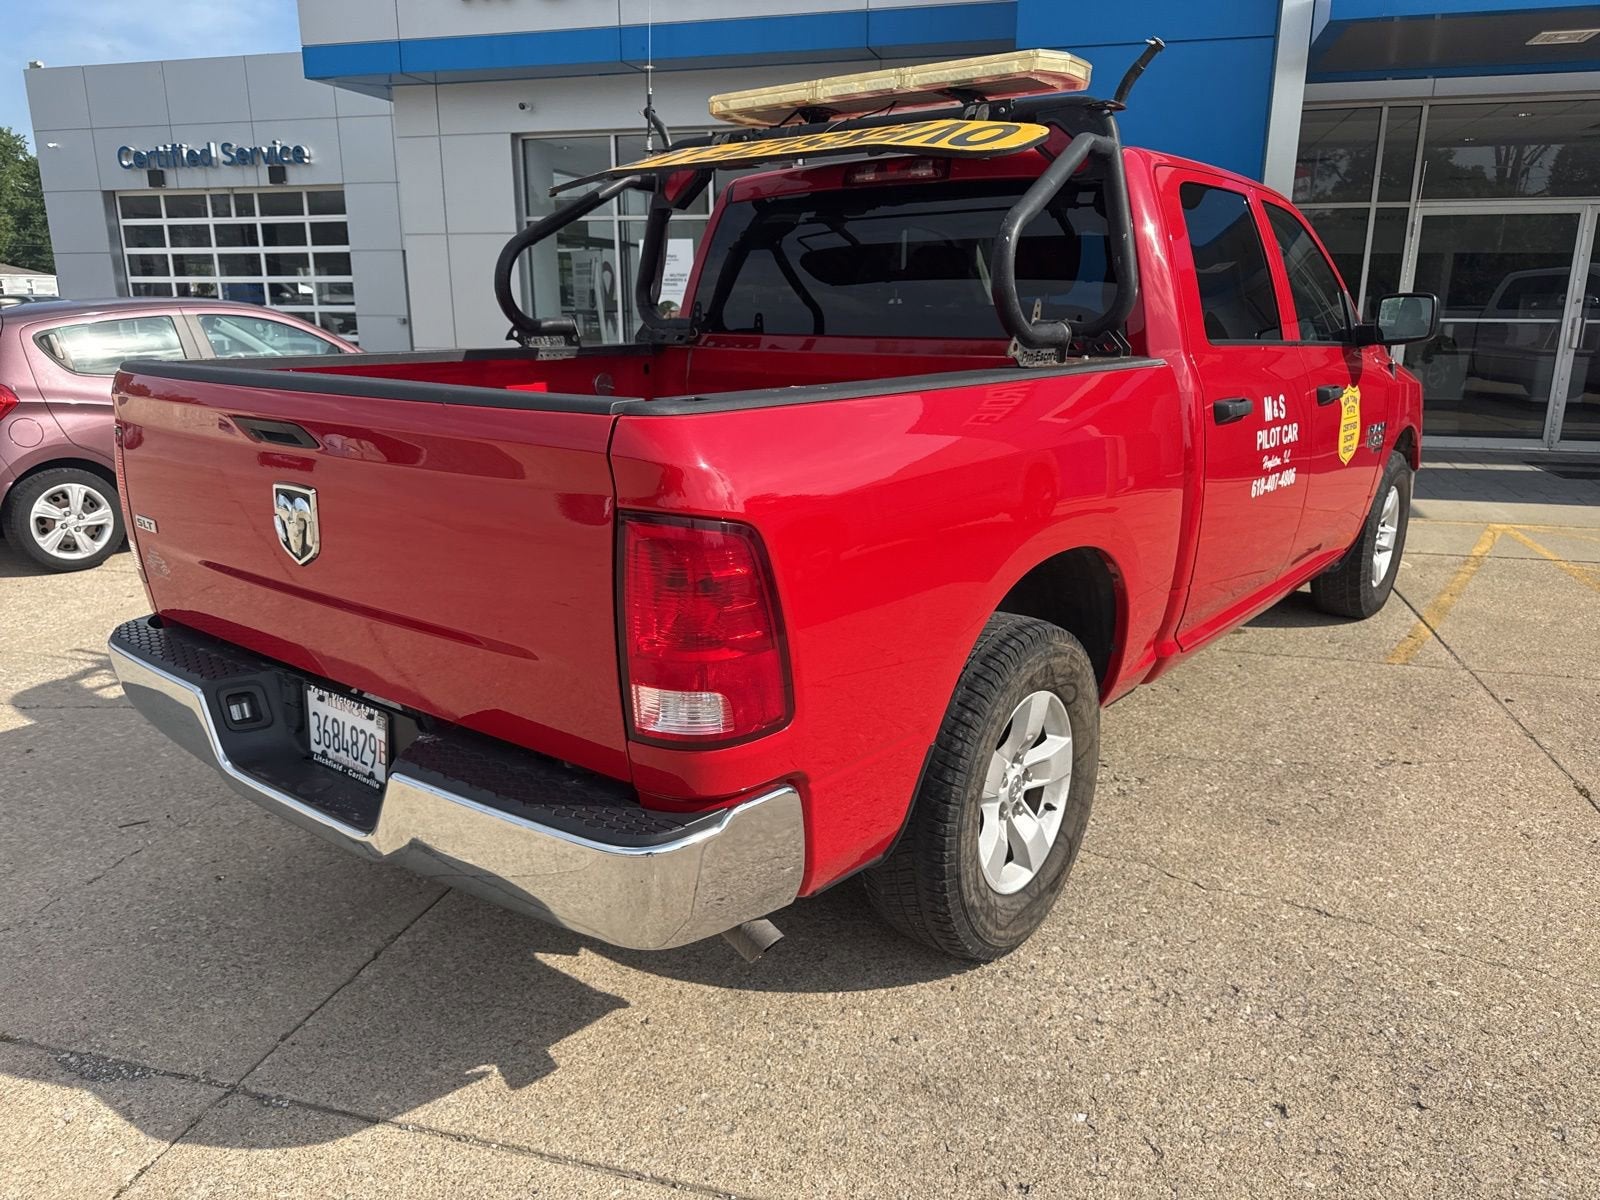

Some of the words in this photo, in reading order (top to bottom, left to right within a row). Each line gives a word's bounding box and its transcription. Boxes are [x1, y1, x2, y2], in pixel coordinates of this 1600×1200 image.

[116, 141, 219, 170] Certified
[220, 139, 311, 167] Service
[1256, 426, 1281, 451] PILOT
[1281, 422, 1299, 445] CAR
[136, 518, 153, 530] SLT
[310, 685, 329, 697] Team
[332, 692, 358, 710] Victory
[361, 704, 379, 717] Lane
[312, 711, 377, 769] 3684829
[313, 754, 343, 771] Litchfield
[347, 769, 380, 789] Carlinville
